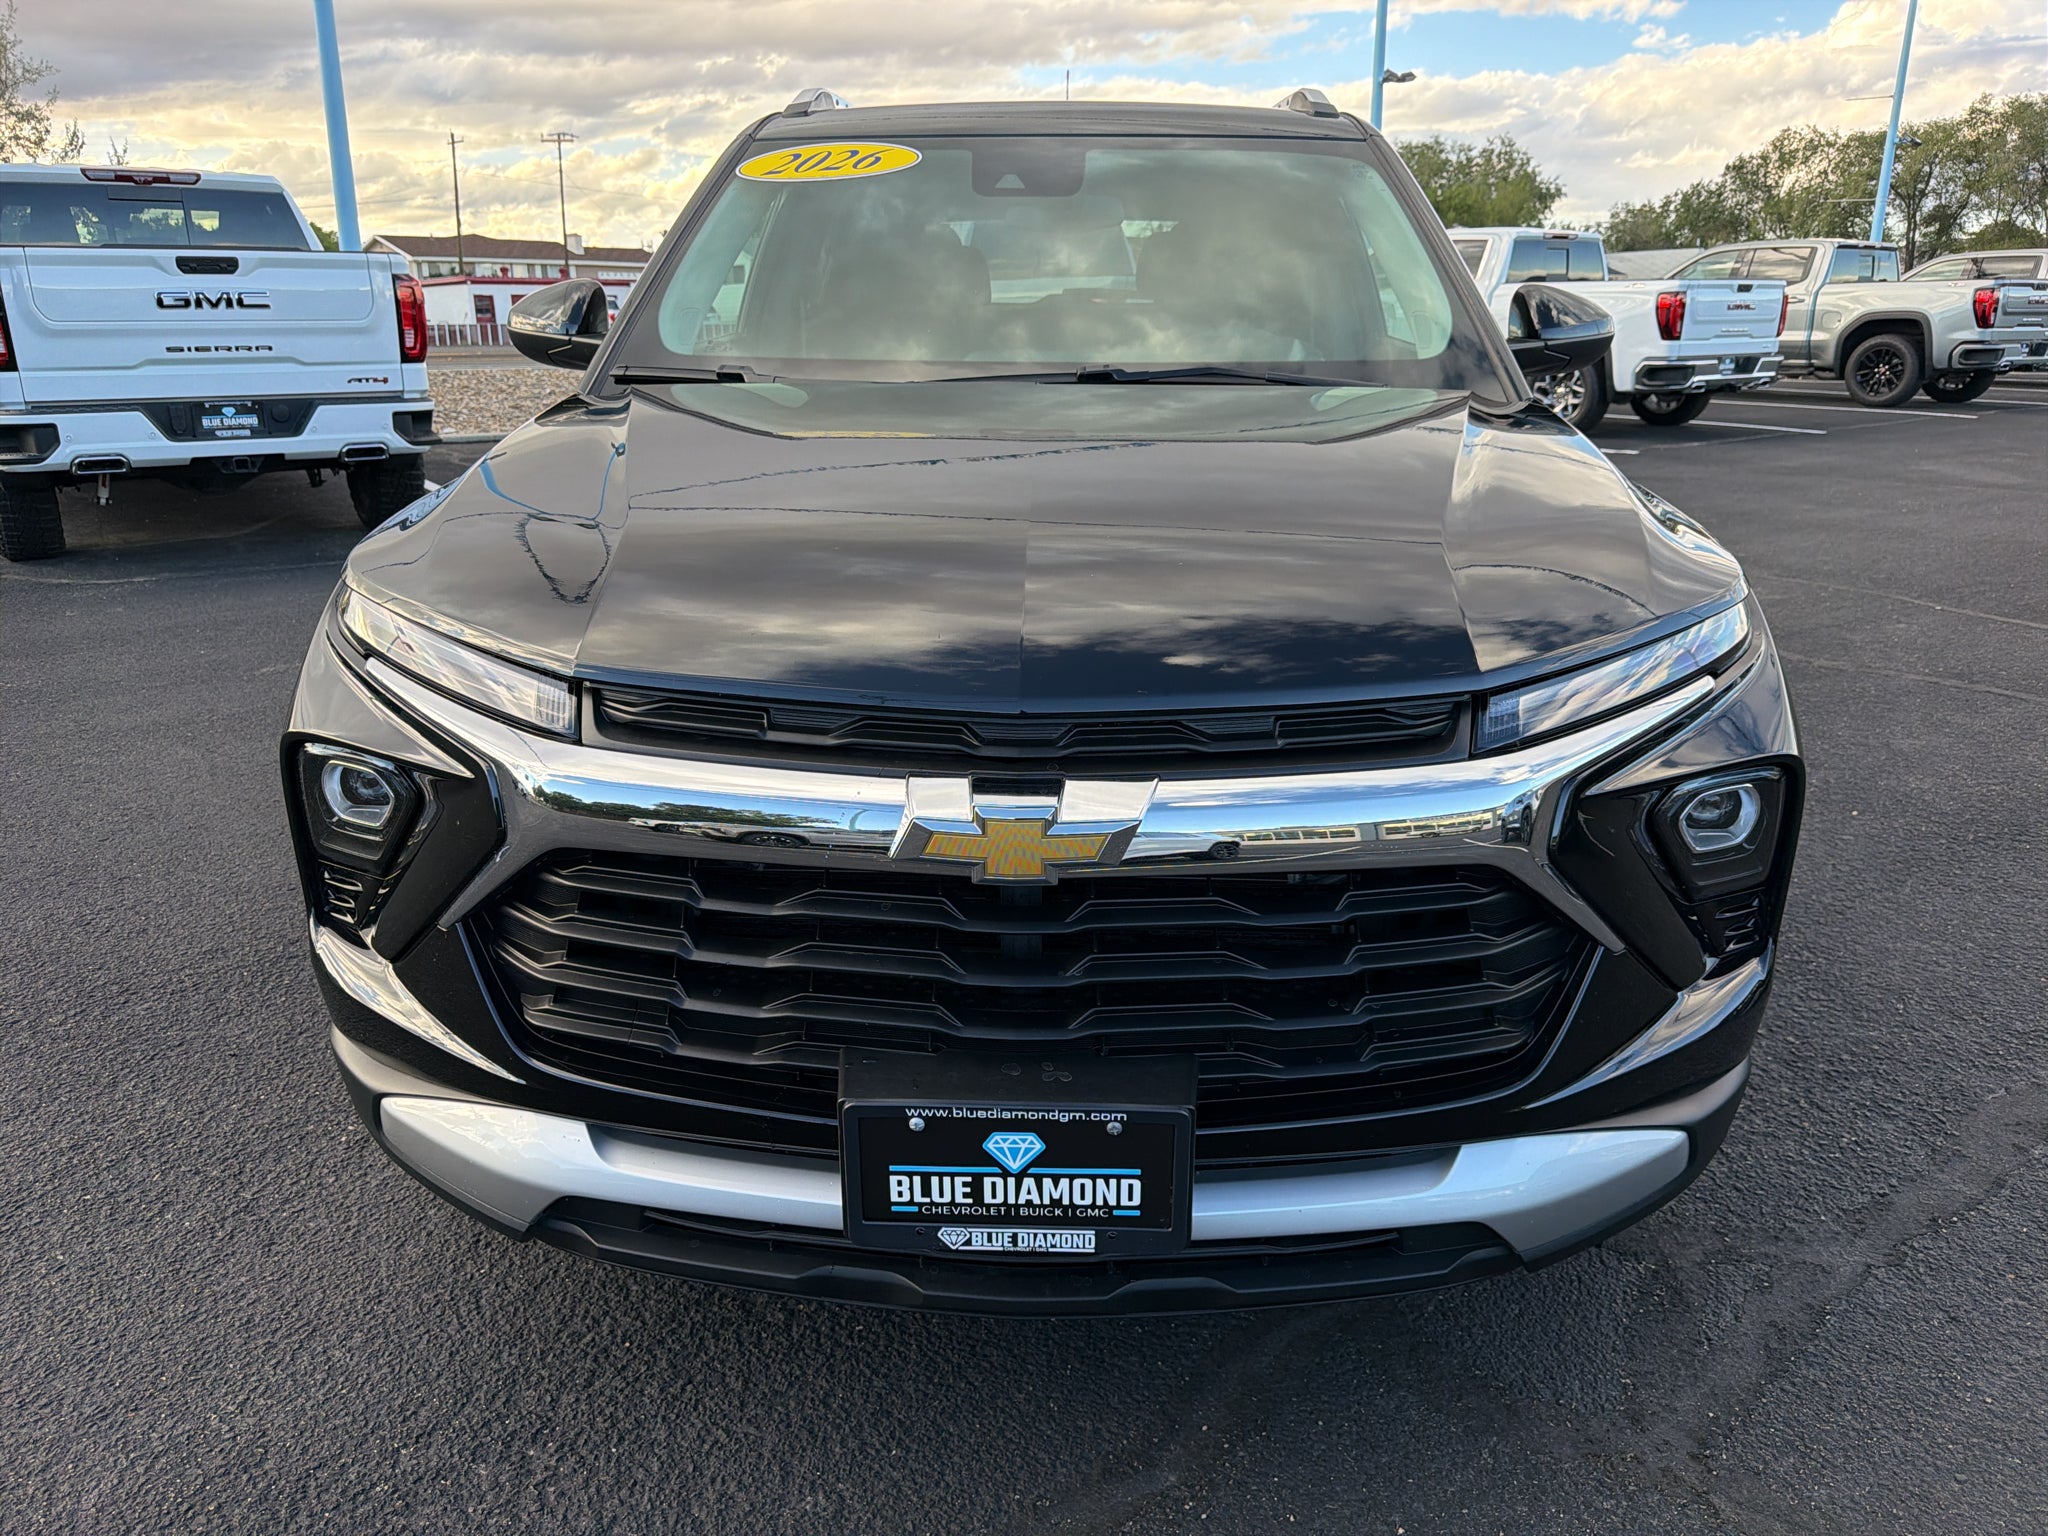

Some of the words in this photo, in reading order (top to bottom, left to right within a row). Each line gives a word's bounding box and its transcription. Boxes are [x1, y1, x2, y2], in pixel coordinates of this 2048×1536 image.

[760, 149, 895, 177] 2026
[155, 290, 271, 310] GMC
[165, 345, 273, 353] SIERRA
[347, 376, 389, 384] AT4
[202, 418, 222, 427] BLUE
[222, 416, 259, 426] DIAMOND
[905, 1107, 1128, 1122] www.bluediamondgm.com
[889, 1175, 973, 1204] BLUE
[983, 1176, 1141, 1207] DIAMOND
[921, 1205, 1007, 1217] CHEVROLET
[1019, 1207, 1064, 1217] BUICK
[1076, 1208, 1110, 1218] GMC
[971, 1231, 1013, 1247] BLUE
[1017, 1232, 1096, 1249] DIAMOND
